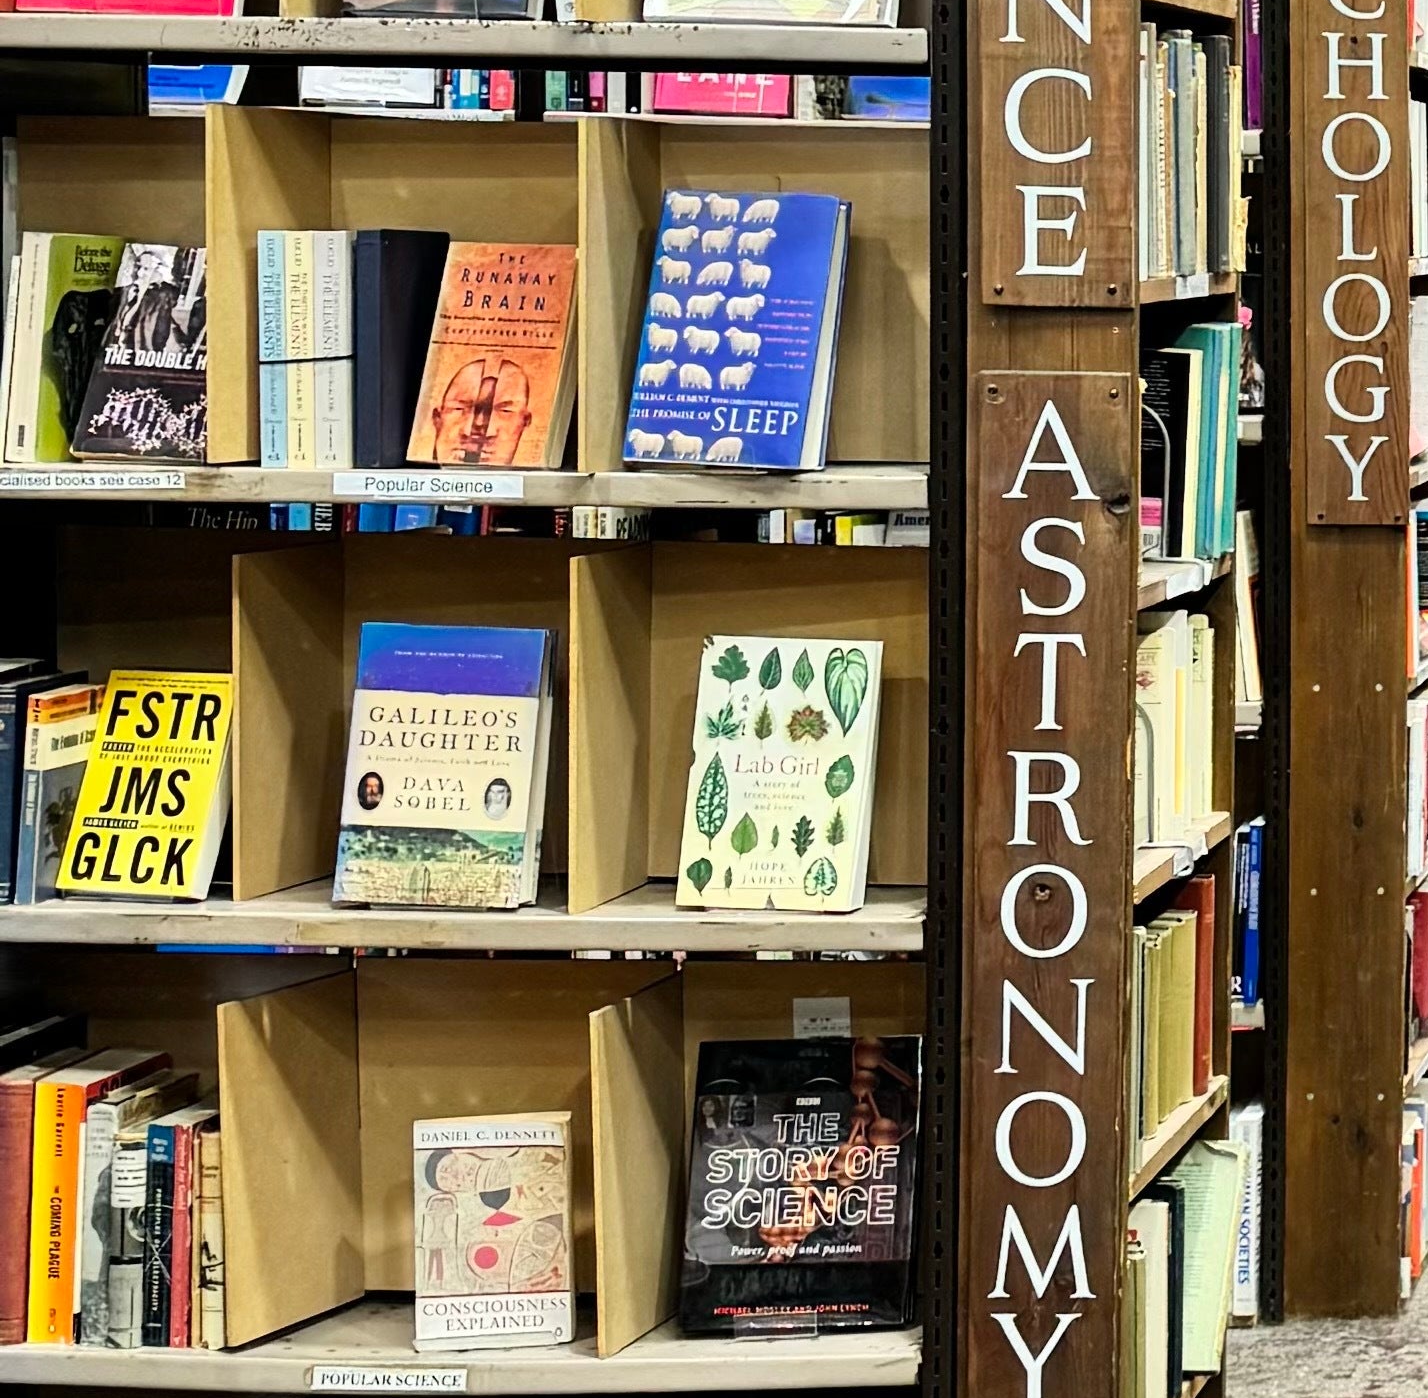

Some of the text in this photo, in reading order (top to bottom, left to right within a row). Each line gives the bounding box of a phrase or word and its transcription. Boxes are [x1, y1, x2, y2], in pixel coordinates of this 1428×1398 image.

[461, 268, 556, 285] RUNAWAY
[463, 291, 547, 311] BRAIN
[105, 348, 194, 369] THE DOUBLE
[653, 409, 695, 420] PROMISE
[698, 411, 711, 420] OF
[711, 406, 798, 435] SLEEP
[365, 477, 492, 493] Popular Science
[106, 690, 221, 741] FSTR
[369, 707, 517, 728] GALILEO'S
[359, 730, 522, 752] DAUGHTER
[734, 754, 819, 775] Lab Girl
[99, 766, 191, 817] JMS
[404, 777, 464, 791] DAVA
[394, 795, 471, 811] SOBEL
[71, 832, 193, 886] GLCK
[773, 1113, 840, 1142] THE
[706, 1146, 899, 1184] STORY OF
[701, 1185, 897, 1229] SCIENCE
[422, 1296, 569, 1318] CONSCIOUSNESS
[445, 1315, 546, 1333] EXPLAINED
[319, 1372, 462, 1389] POPULAR SCIENCE
